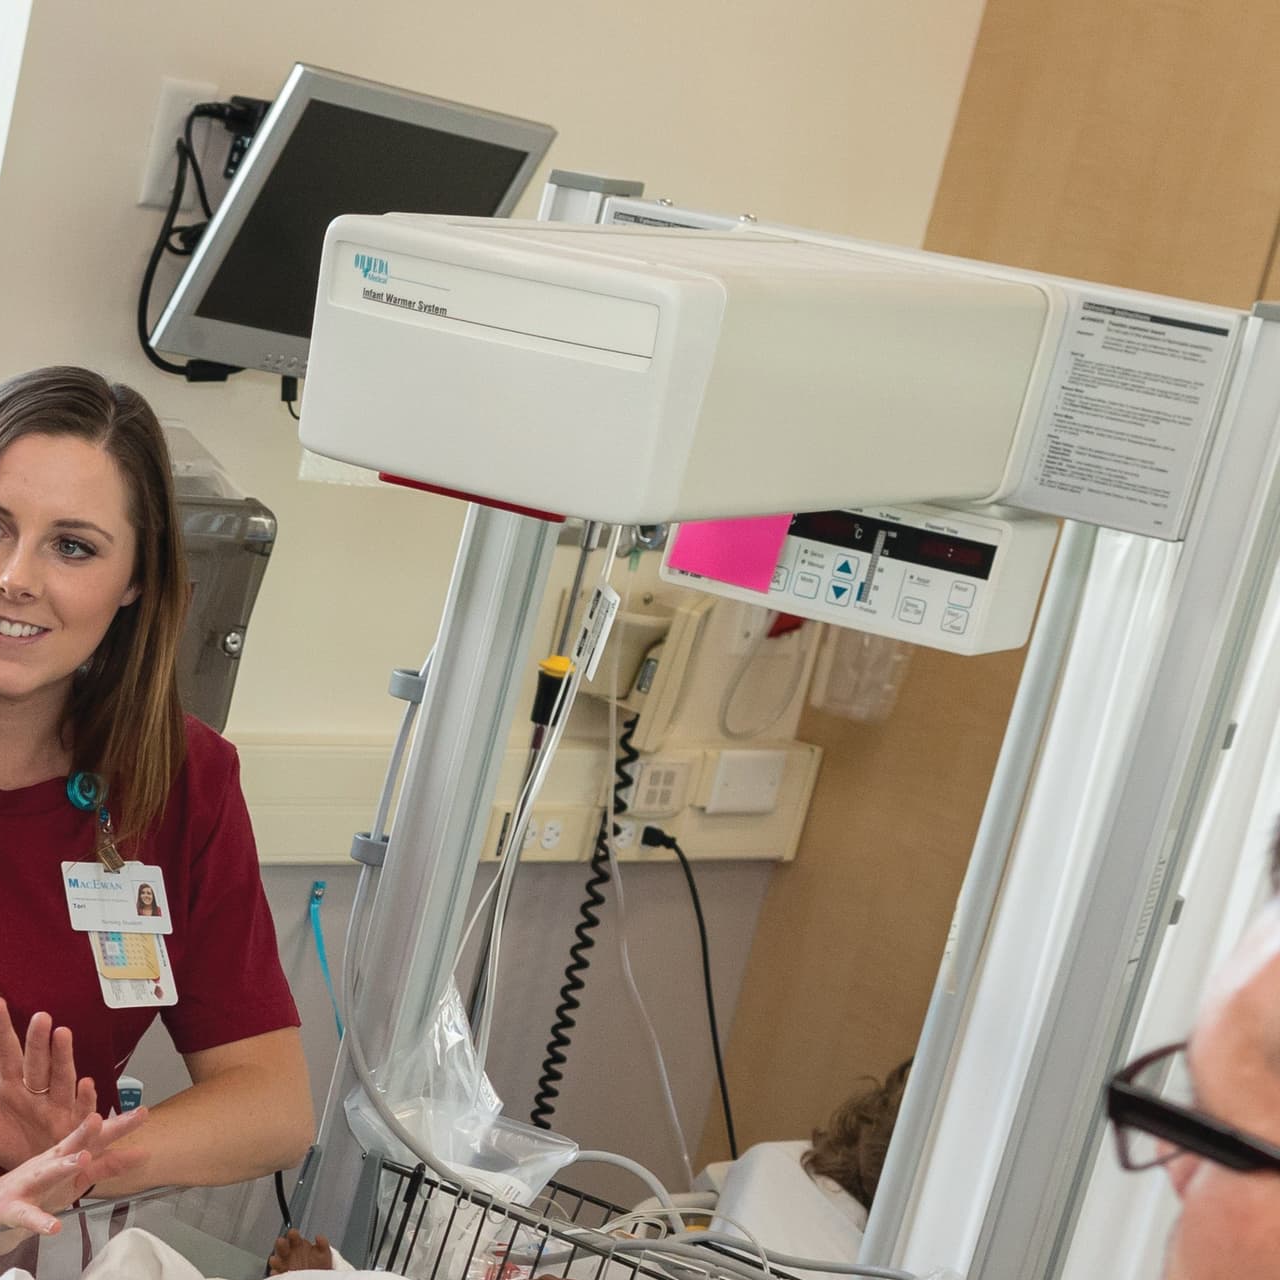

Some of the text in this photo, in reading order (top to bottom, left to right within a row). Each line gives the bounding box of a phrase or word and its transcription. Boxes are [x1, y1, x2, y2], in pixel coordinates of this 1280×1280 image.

[363, 288, 448, 316] Infant Warmer System
